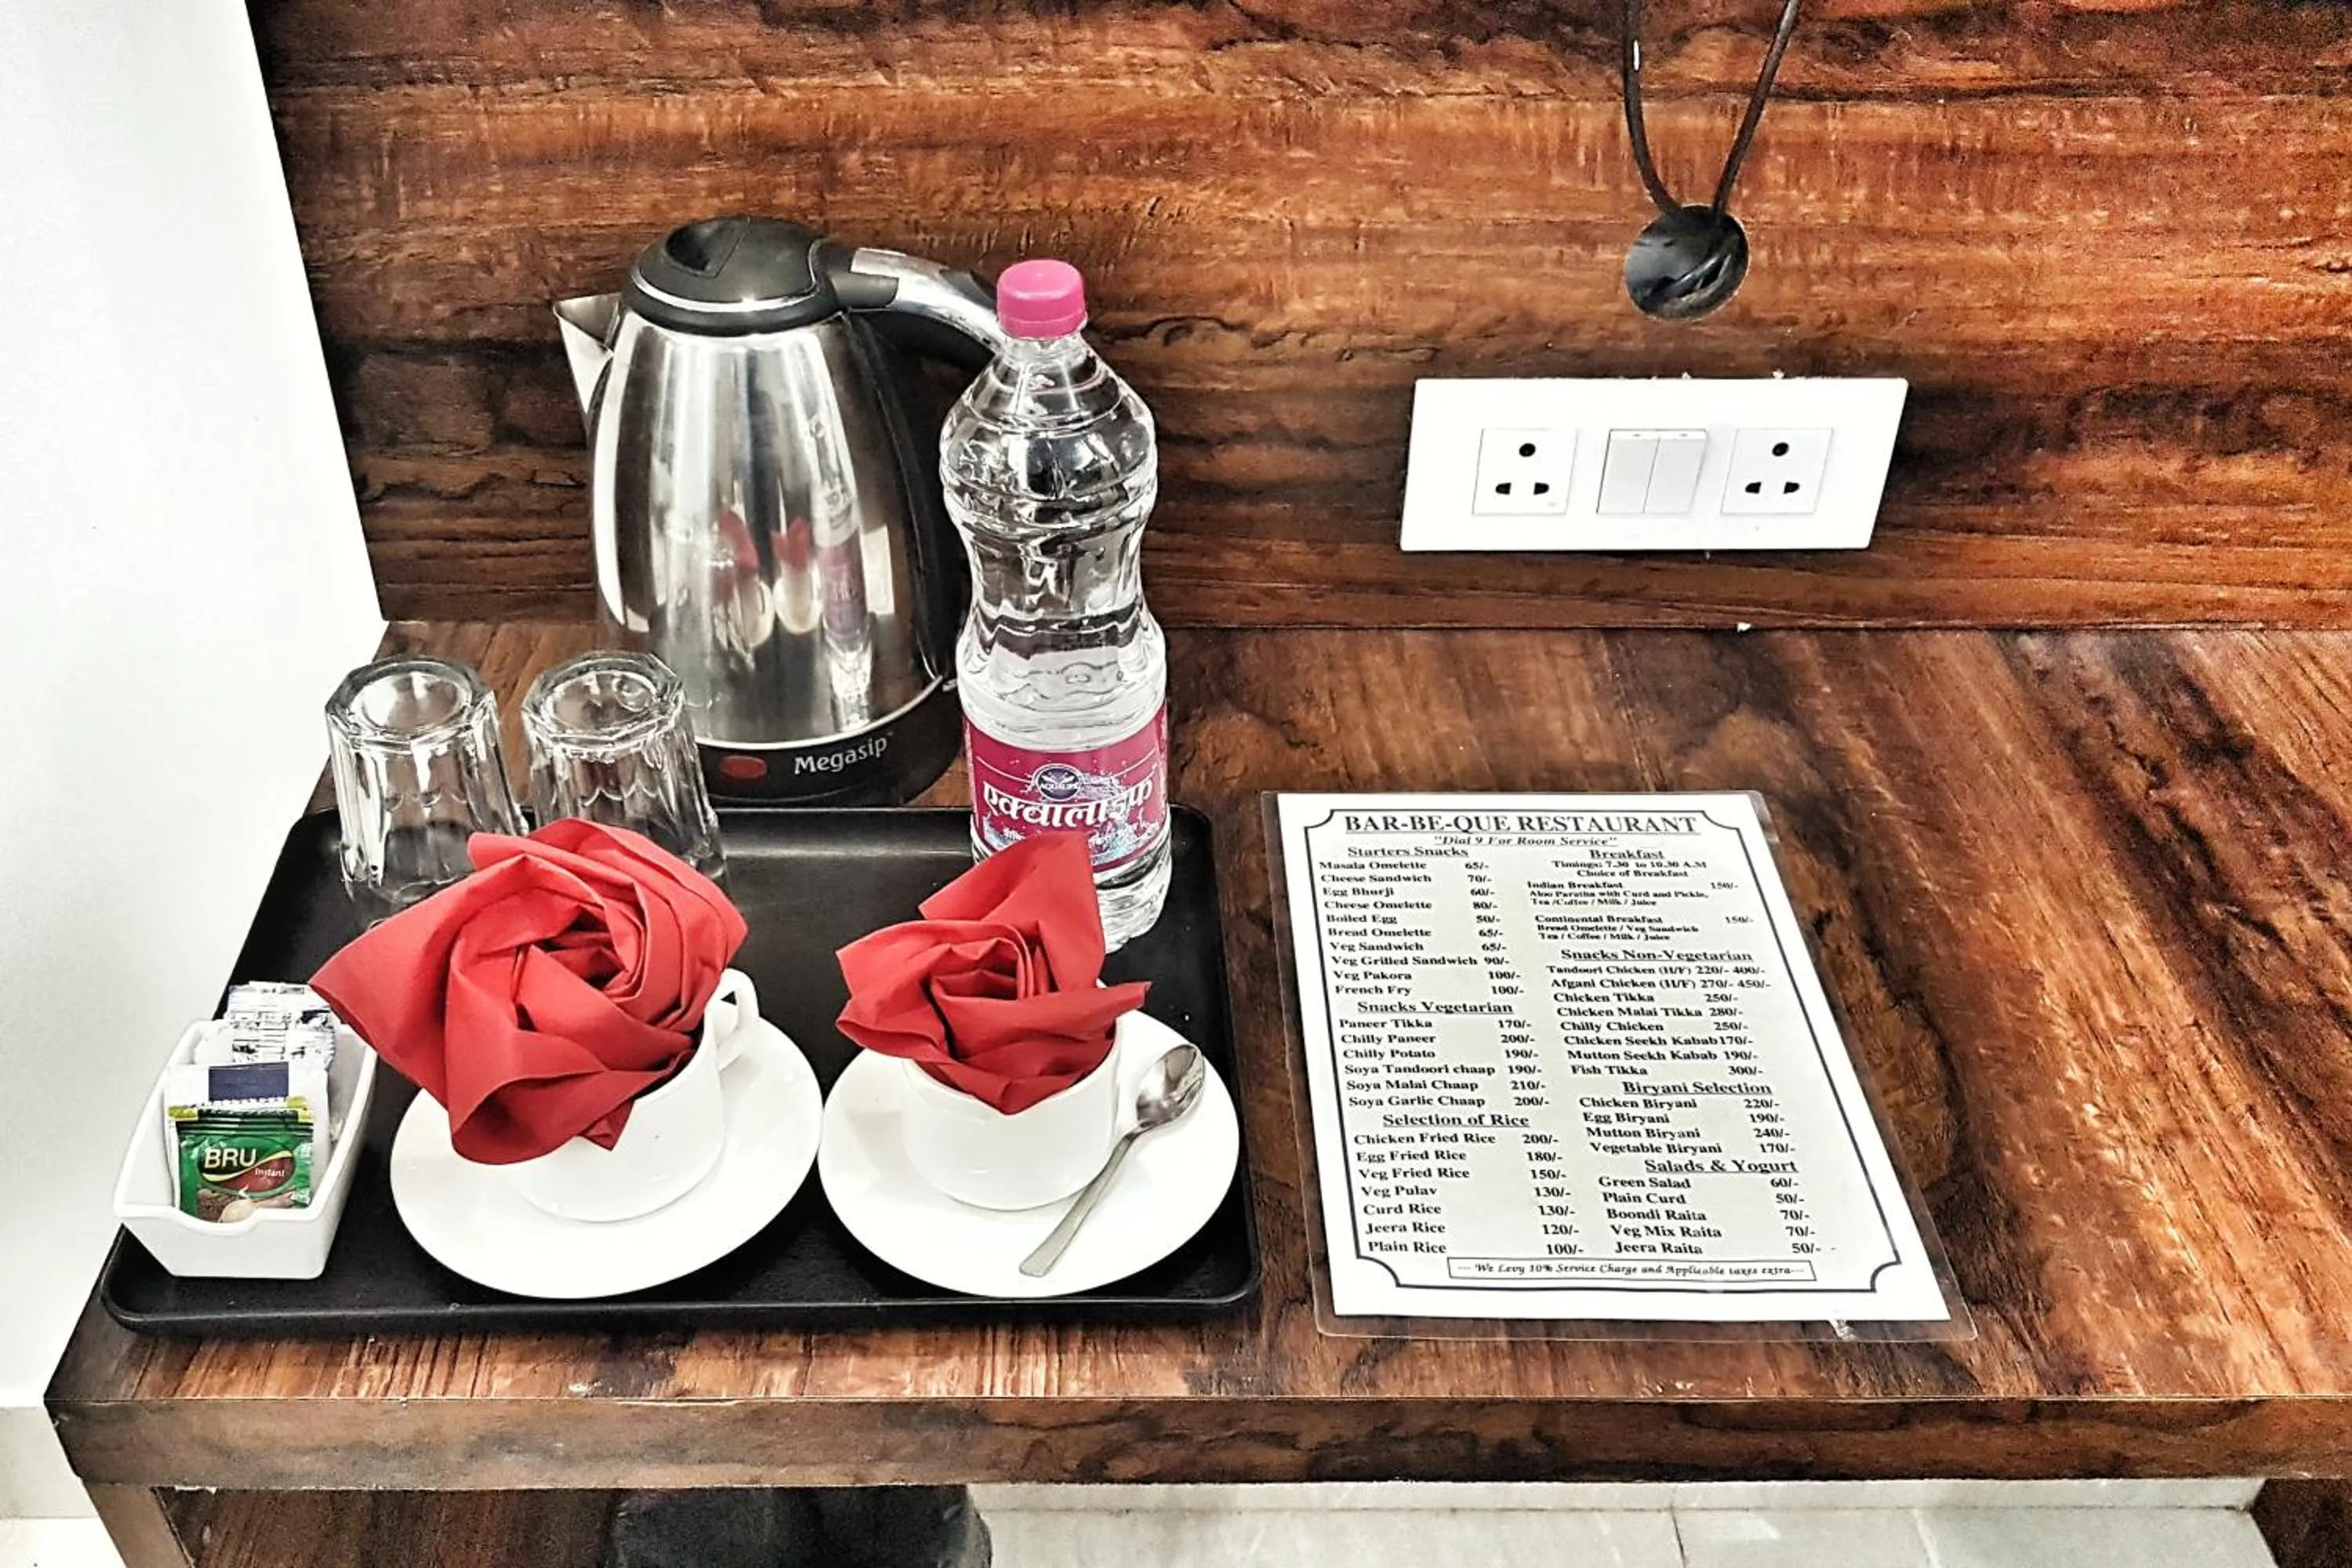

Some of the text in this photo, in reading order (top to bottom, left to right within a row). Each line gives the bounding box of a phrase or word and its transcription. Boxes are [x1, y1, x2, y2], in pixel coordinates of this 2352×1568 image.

[794, 736, 887, 775] Megasip
[1344, 815, 1697, 834] BAR-BE-QUE RESTAURANT
[1348, 847, 1468, 856] Starters Snacks
[1589, 850, 1664, 859] Breakfast
[1330, 942, 1424, 952] Veg Sandwich
[1331, 956, 1509, 966] Veg Grilled Sandwich 90/-
[1560, 949, 1753, 961] Snacks Non-Vegetarian
[1334, 971, 1359, 981] Veg
[1552, 979, 1595, 989] Afgani
[1599, 979, 1656, 988] Chicken
[1335, 985, 1524, 996] French Fry 100/-
[1554, 993, 1738, 1002] Chicken Tikka 250/-
[1357, 1001, 1514, 1014] Snacks Vegetarian
[1557, 1007, 1613, 1016] Chicken
[1618, 1007, 1657, 1016] Malai
[1661, 1007, 1703, 1016] Tikka
[1339, 1019, 1387, 1028] Paneer
[1391, 1018, 1432, 1028] Tikka
[1560, 1022, 1602, 1032] Chilly
[1607, 1022, 1664, 1031] Chicken
[1341, 1034, 1382, 1044] Chilly
[1501, 1035, 1535, 1044] 200/-
[1564, 1036, 1753, 1046] Chicken Seekh Kabab 170/-
[1343, 1049, 1539, 1060] Chilly Potato 190/-
[1568, 1051, 1758, 1060] Mutton Seekh Kabab 190/-
[1345, 1064, 1542, 1076] Soya Tandoori chaap 190/-
[1571, 1065, 1763, 1076] Fish Tikka 300/-
[1347, 1080, 1546, 1091] Soya Malai Chaap 210/-
[1623, 1082, 1772, 1095] Biryani Selection
[1349, 1096, 1550, 1109] Soya Garlic Chaap 200/-
[1580, 1098, 1780, 1110] Chicken Biryani 220/-
[1383, 1114, 1530, 1127] Selection of Rice
[1583, 1112, 1785, 1124] Egg Biryani 190/-
[1354, 1133, 1559, 1145] Chicken Fried Rice 200/-
[1587, 1127, 1790, 1140] Mutton Biryani 240/-
[1590, 1142, 1795, 1156] Vegetable Biryani 170/-
[205, 1147, 256, 1168] BRU
[1356, 1150, 1563, 1163] Egg Fried Rice 180/-
[255, 1168, 285, 1177] Instant
[1644, 1159, 1798, 1174] Salads & Yogurt
[1359, 1168, 1566, 1180] Veg Fried Rice 150/-
[1599, 1177, 1799, 1189] Green Salad 60/-
[1361, 1185, 1571, 1197] Veg Pulav 130/-
[1602, 1192, 1805, 1204] Plain Curd 50/-
[1363, 1203, 1575, 1216] Curd Rice 130/-
[1606, 1208, 1809, 1221] Boondi Raita 70/-
[1365, 1222, 1579, 1235] Jeera Rice 120/-
[1610, 1225, 1816, 1237] Veg Mix Raita 70/-
[1368, 1241, 1584, 1255] Plain Rice 100/-
[1614, 1241, 1821, 1254] Jeera Raita 50/-
[1555, 1264, 1595, 1272] Service
[1599, 1264, 1637, 1275] Charge
[1642, 1265, 1662, 1273] and
